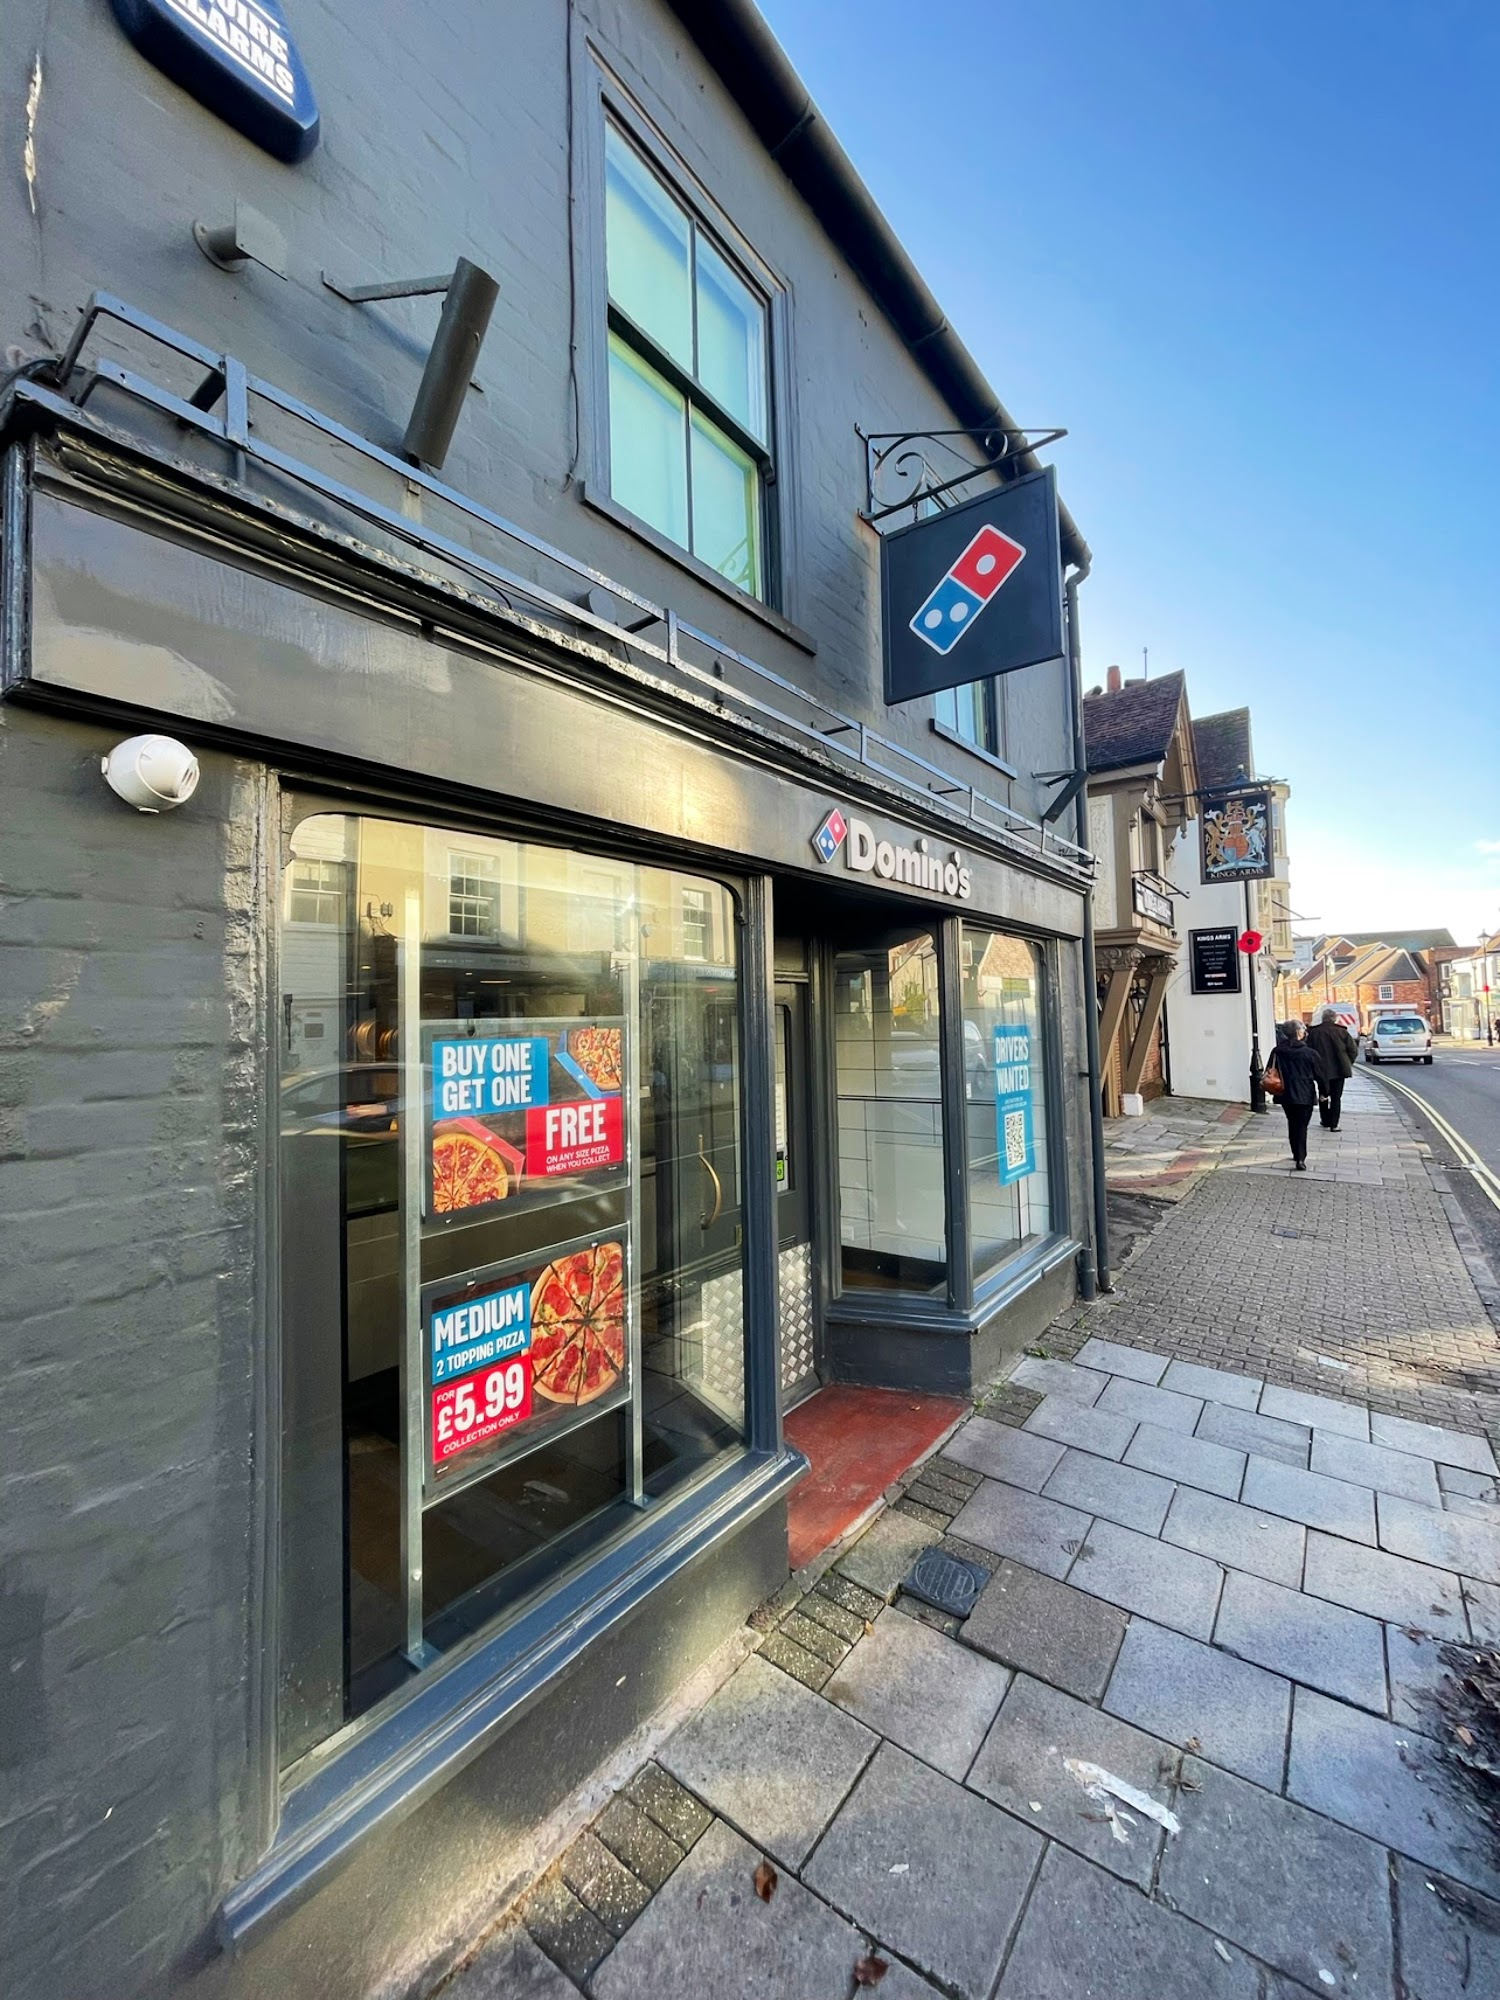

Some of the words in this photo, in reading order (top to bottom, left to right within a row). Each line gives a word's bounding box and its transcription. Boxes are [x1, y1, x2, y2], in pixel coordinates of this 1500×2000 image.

[173, 0, 294, 94] LARMS
[209, 0, 288, 65] UIRE
[847, 817, 971, 900] Domino's
[1210, 870, 1237, 879] KINGS
[1239, 868, 1264, 876] ARMS
[442, 1044, 487, 1077] BUY
[491, 1042, 532, 1073] ONE
[995, 1036, 1028, 1064] DRIVERS
[442, 1078, 485, 1112] GET
[491, 1074, 532, 1106] ONE
[996, 1064, 1029, 1095] WANTED
[546, 1102, 607, 1151] FREE
[546, 1155, 558, 1165] ON
[559, 1151, 574, 1162] ANY
[575, 1148, 590, 1159] SIZE
[590, 1145, 610, 1156] PIZZA
[546, 1162, 567, 1173] WHEN
[567, 1158, 582, 1169] YOU
[582, 1153, 610, 1166] COLLECT
[434, 1290, 524, 1353] MEDIUM
[436, 1359, 445, 1377] 2
[446, 1340, 494, 1373] TOPPING
[495, 1329, 526, 1354] PIZZA
[436, 1389, 456, 1405] FOR
[437, 1363, 525, 1443] £5.99
[443, 1421, 498, 1455] COLLECTION
[498, 1411, 521, 1428] ONLY
